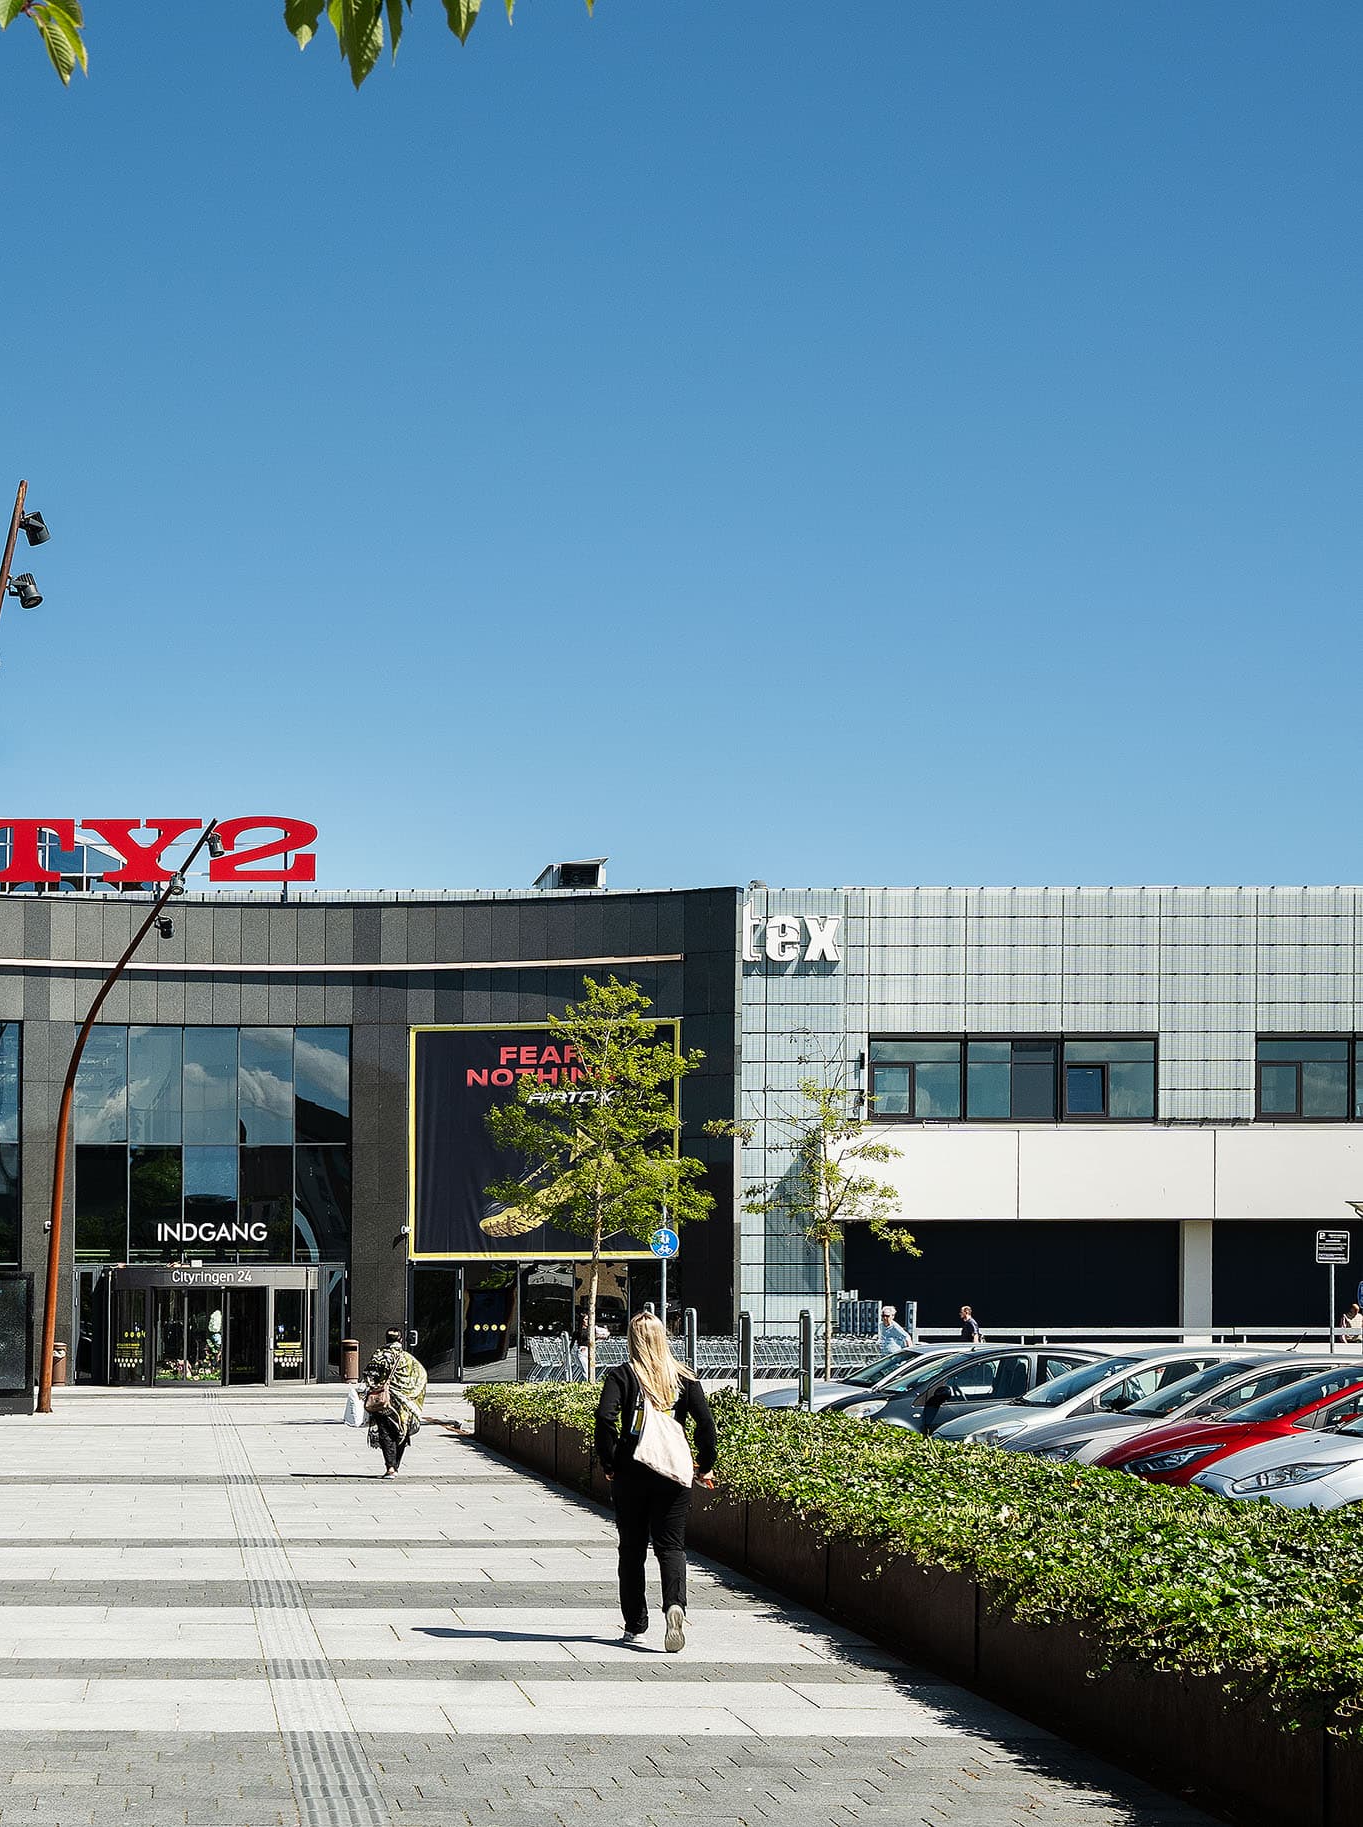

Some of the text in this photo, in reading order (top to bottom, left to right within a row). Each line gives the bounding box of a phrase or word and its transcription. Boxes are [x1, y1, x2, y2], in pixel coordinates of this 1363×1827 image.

[499, 1045, 584, 1065] FEAR
[466, 1067, 617, 1087] NOTHIN
[157, 1222, 268, 1242] INDGANG
[172, 1270, 253, 1285] Cityringen 24
